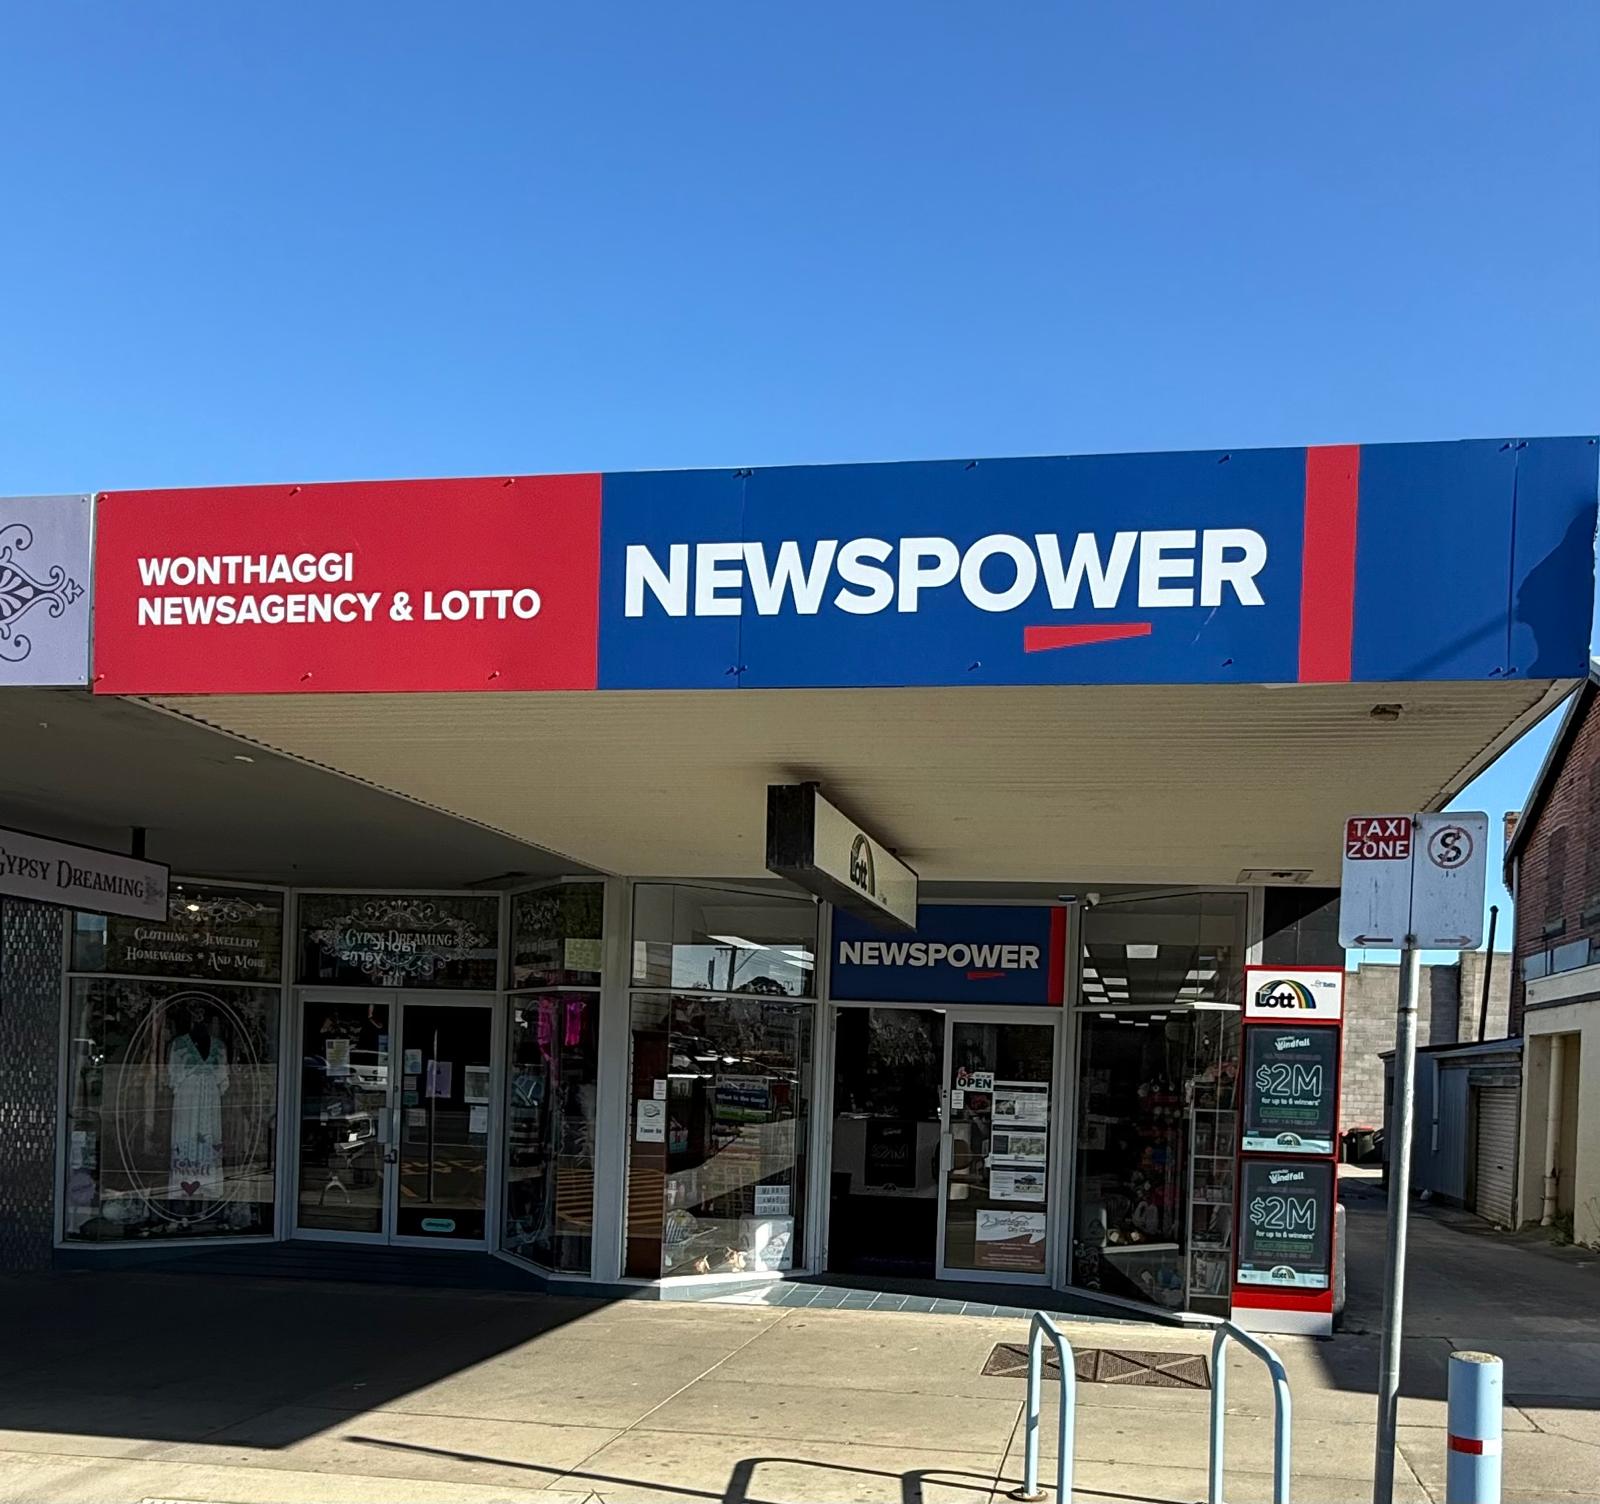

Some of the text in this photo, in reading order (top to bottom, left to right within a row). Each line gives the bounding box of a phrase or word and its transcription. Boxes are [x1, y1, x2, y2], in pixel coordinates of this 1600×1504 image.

[137, 552, 354, 587] WONTHAGGI
[624, 528, 1268, 618] NEWSPOWER
[137, 588, 541, 626] NEWSAGENCY & LOTTO
[1353, 819, 1406, 837] TAXI
[1347, 841, 1409, 858] ZONE
[839, 941, 1040, 969] NEWSPOWER
[1254, 991, 1295, 1009] Lott
[1274, 1037, 1311, 1051] Windfall
[957, 1077, 992, 1089] OPEN
[1255, 1063, 1323, 1098] $2M
[1268, 1171, 1305, 1184] Windfall
[1249, 1196, 1317, 1231] $2M
